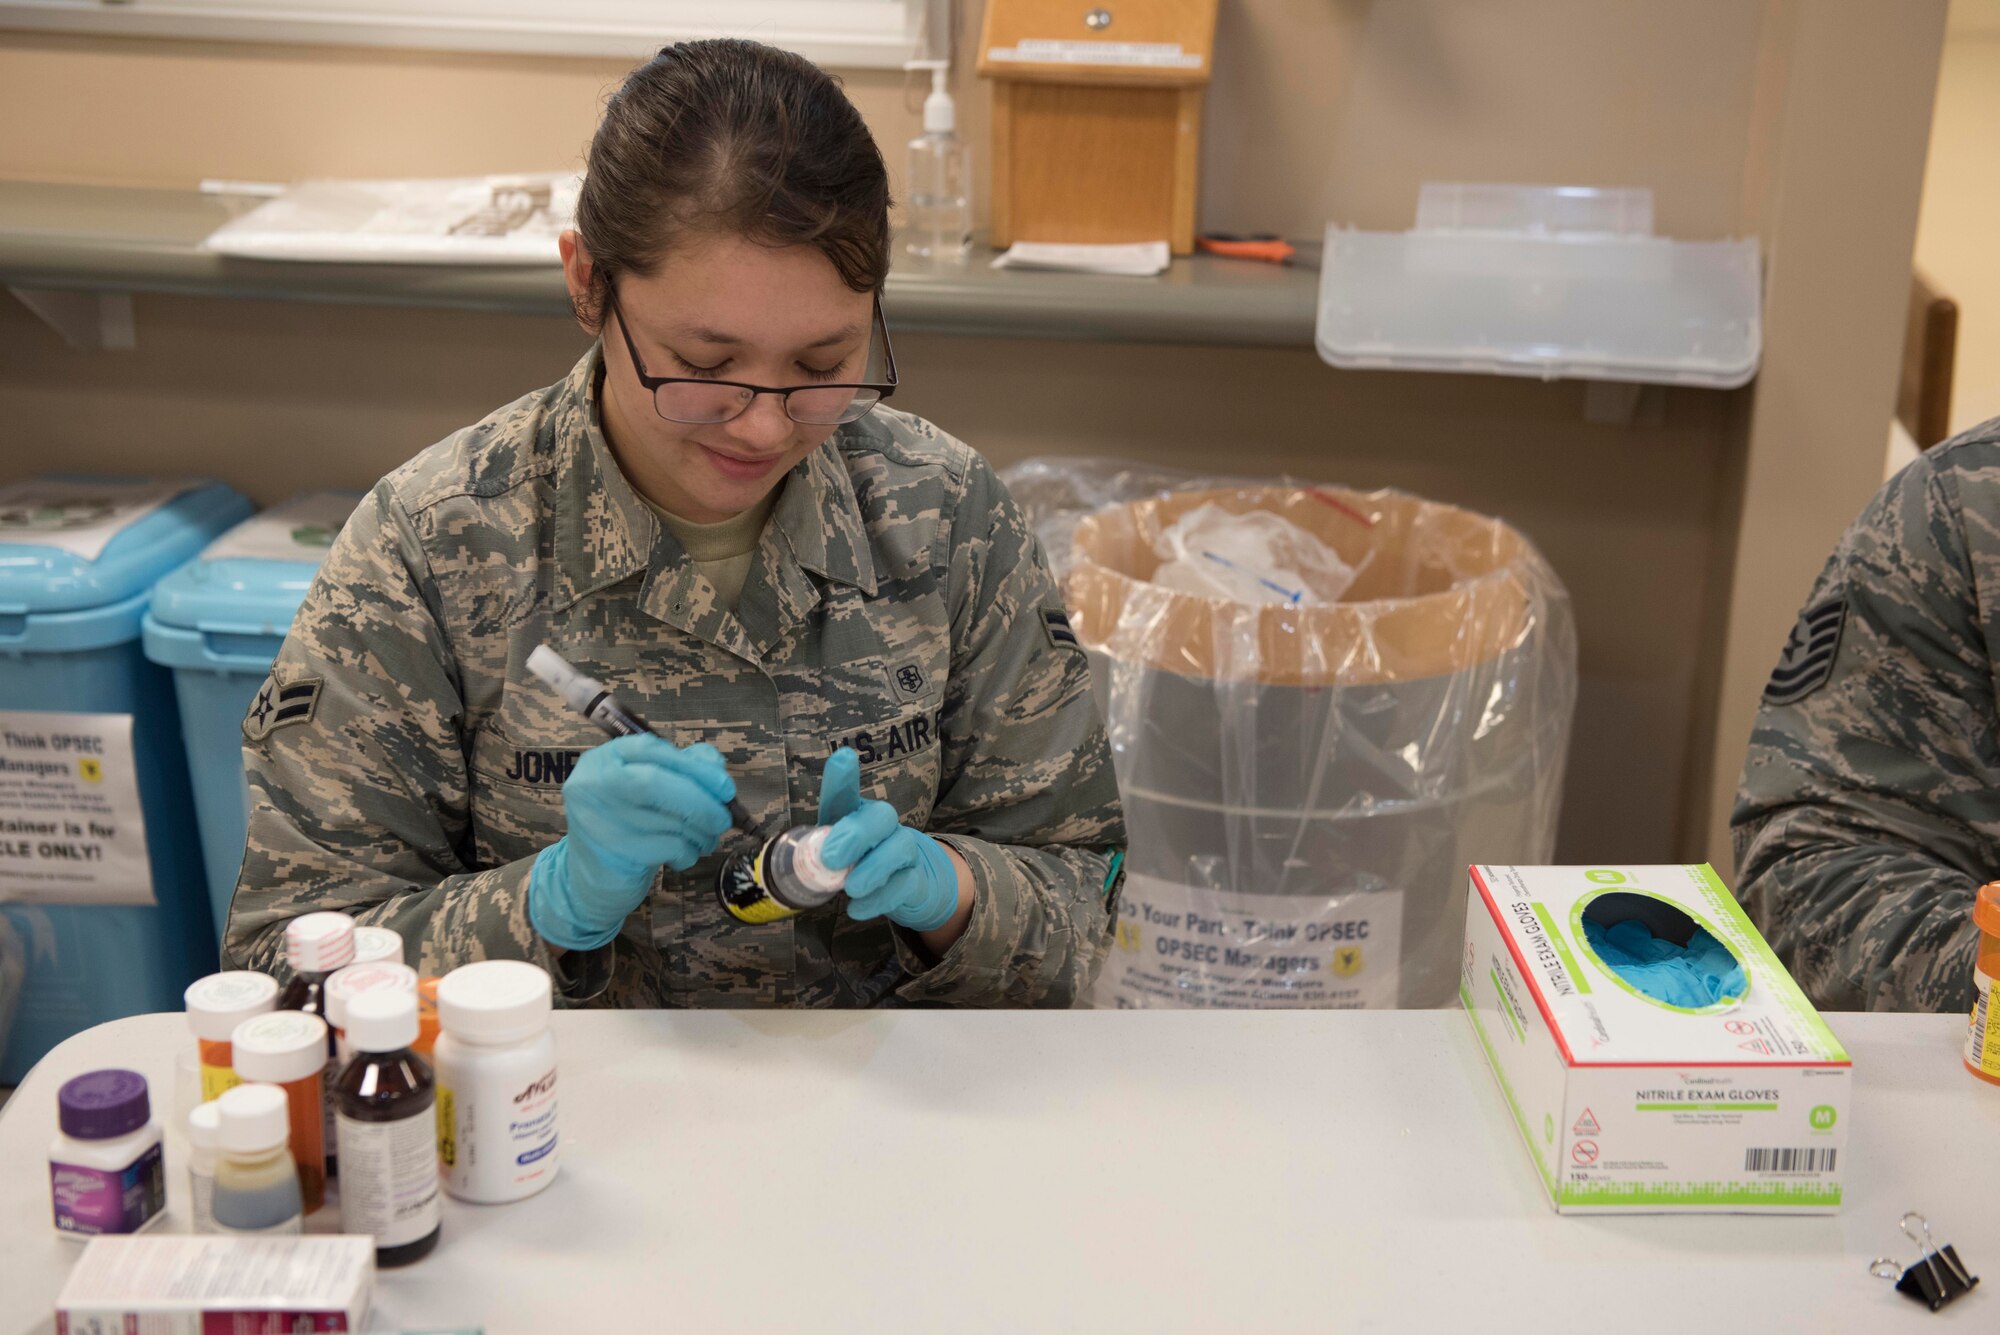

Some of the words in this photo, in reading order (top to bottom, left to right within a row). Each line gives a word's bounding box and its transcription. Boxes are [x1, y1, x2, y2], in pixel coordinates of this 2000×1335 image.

[4, 732, 46, 749] Think
[51, 734, 104, 753] OPSEC
[889, 714, 932, 758] AIR
[64, 822, 82, 839] is
[89, 823, 116, 840] for
[37, 843, 103, 862] ONLY!
[1141, 902, 1181, 928] Your
[1186, 913, 1225, 937] Part
[1304, 920, 1370, 943] OPSEC
[1511, 902, 1541, 935] GLOVES
[1156, 936, 1218, 964] OPSEC
[1533, 932, 1556, 964] EXAM
[1543, 960, 1575, 997] NITRILE
[1636, 1090, 1684, 1101] NITRILE
[1687, 1090, 1725, 1101] EXAM
[1728, 1090, 1779, 1101] GLOVES
[1815, 1110, 1830, 1123] M
